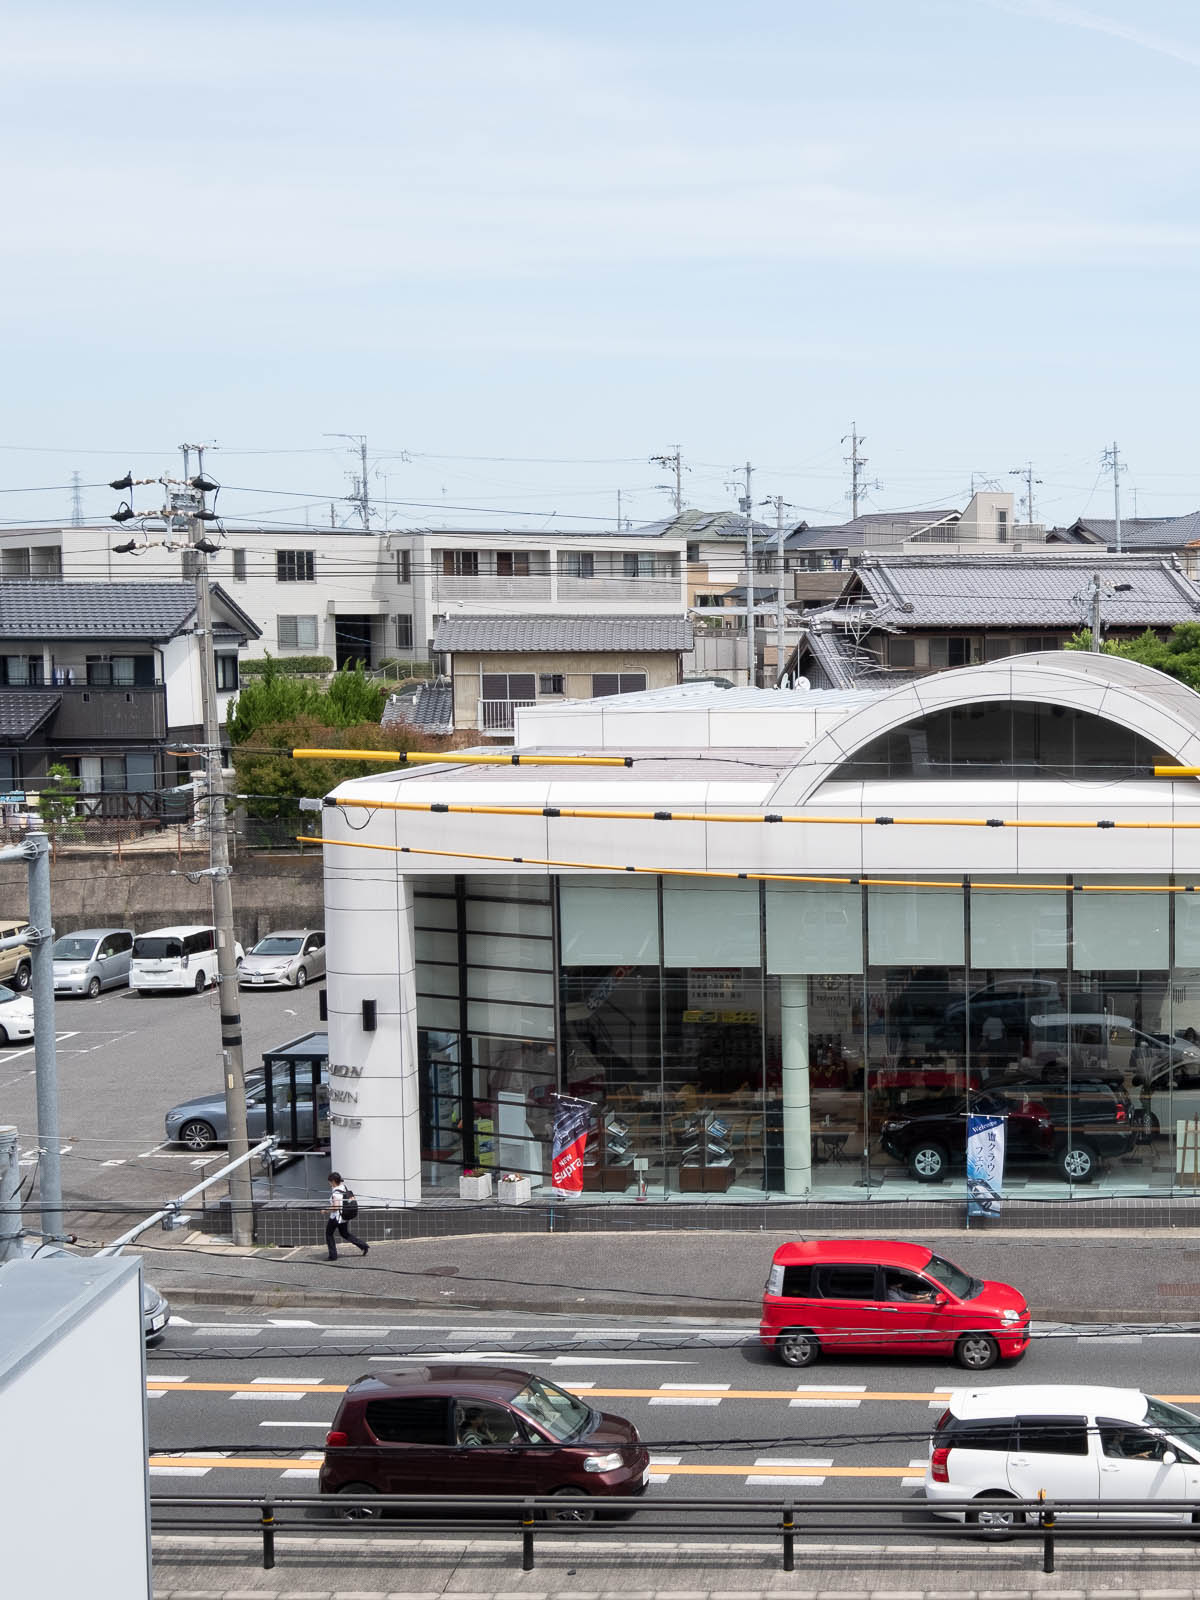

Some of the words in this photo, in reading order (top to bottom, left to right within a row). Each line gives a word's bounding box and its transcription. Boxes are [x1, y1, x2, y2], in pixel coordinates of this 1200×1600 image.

[971, 1120, 998, 1133] Welcome
[558, 1153, 573, 1167] NEW
[987, 1143, 996, 1181] クラウン
[554, 1157, 583, 1184] Supra
